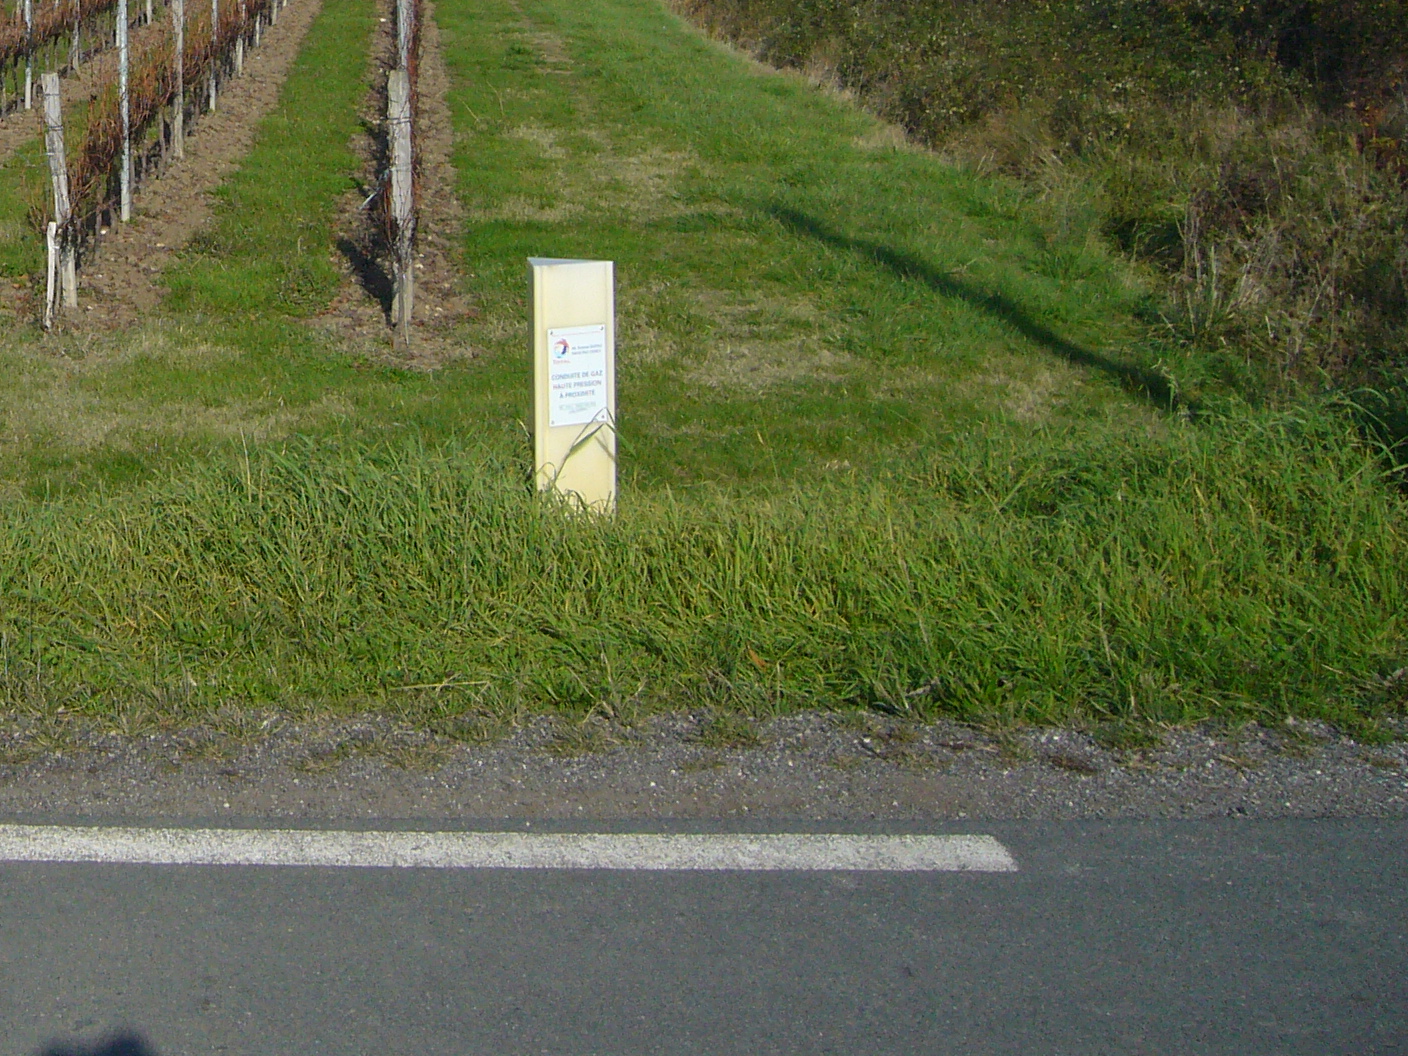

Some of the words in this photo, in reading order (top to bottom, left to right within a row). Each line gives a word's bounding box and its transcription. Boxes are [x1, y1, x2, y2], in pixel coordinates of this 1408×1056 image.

[551, 372, 580, 381] CONDUITE
[553, 382, 572, 390] HAUTE
[573, 380, 602, 388] PRESSION
